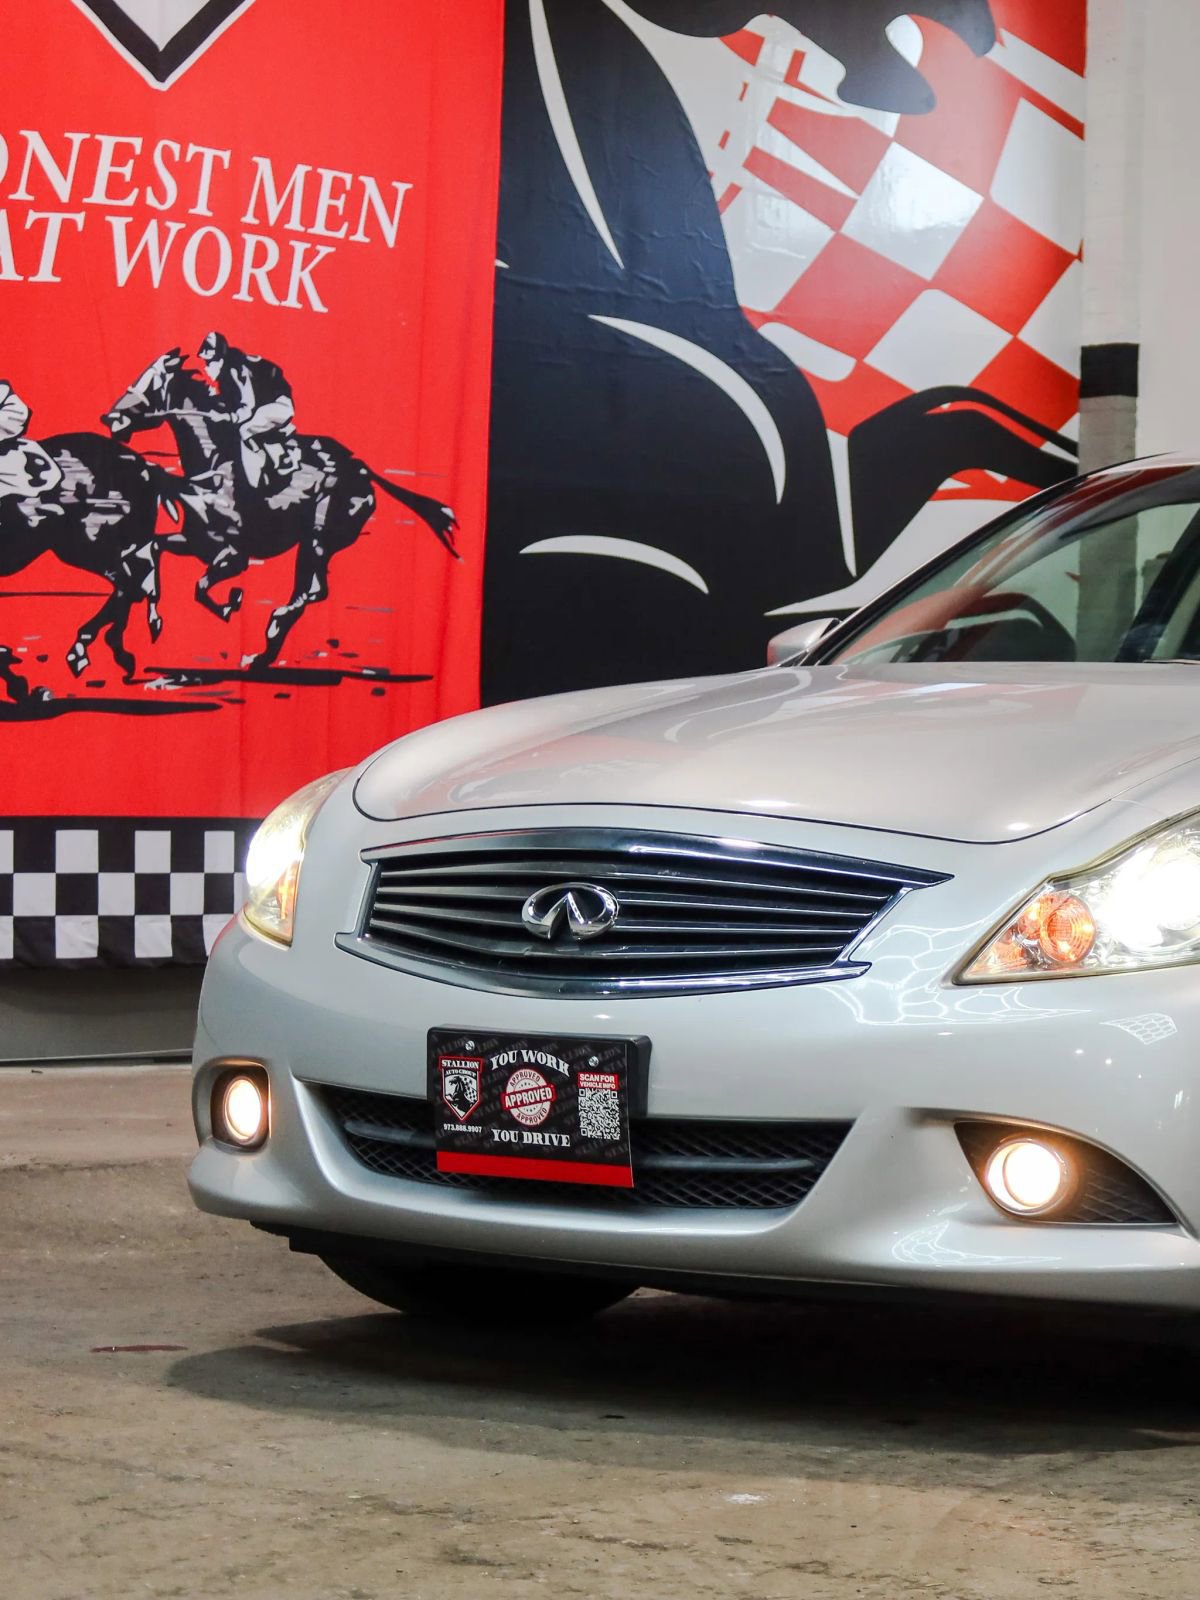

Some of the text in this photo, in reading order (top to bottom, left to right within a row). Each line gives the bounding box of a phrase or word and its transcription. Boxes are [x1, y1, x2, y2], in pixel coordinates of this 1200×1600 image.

[0, 129, 413, 248] NEST MEN
[105, 215, 337, 313] WORK
[441, 1059, 480, 1069] STALLION
[490, 1049, 519, 1071] YOU
[520, 1049, 570, 1077] WORK
[509, 1070, 541, 1087] APPROVED
[579, 1073, 616, 1084] SCAN FOR
[579, 1080, 602, 1089] VEHICLE
[505, 1087, 553, 1109] APPROVED
[516, 1107, 548, 1124] APPROVED
[491, 1128, 519, 1143] YOU
[522, 1131, 571, 1147] DRIVE
